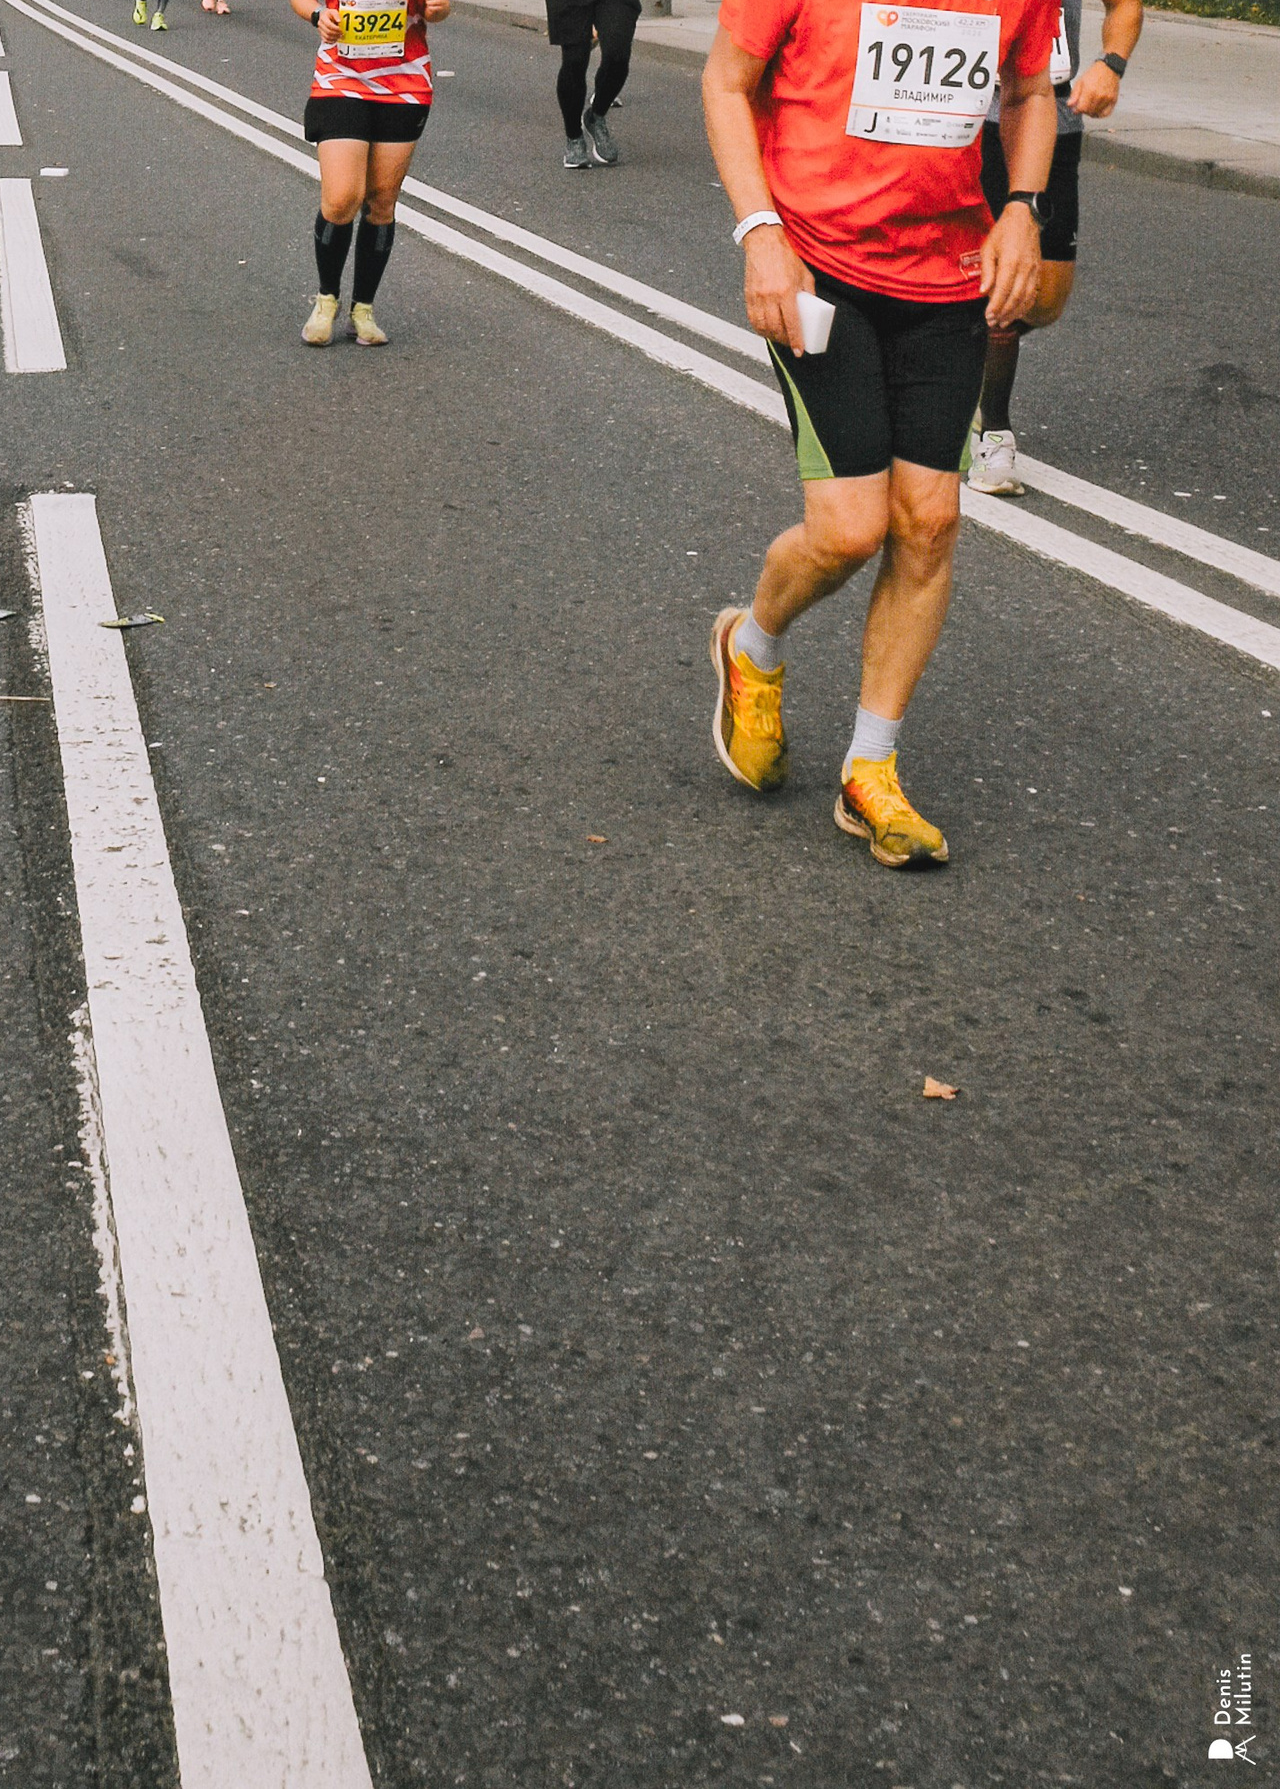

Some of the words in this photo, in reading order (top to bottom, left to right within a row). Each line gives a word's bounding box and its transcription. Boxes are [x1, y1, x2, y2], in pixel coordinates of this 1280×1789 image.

[342, 12, 404, 33] 13924
[867, 40, 990, 90] 19126
[893, 88, 955, 104] ВЛАДИМИР
